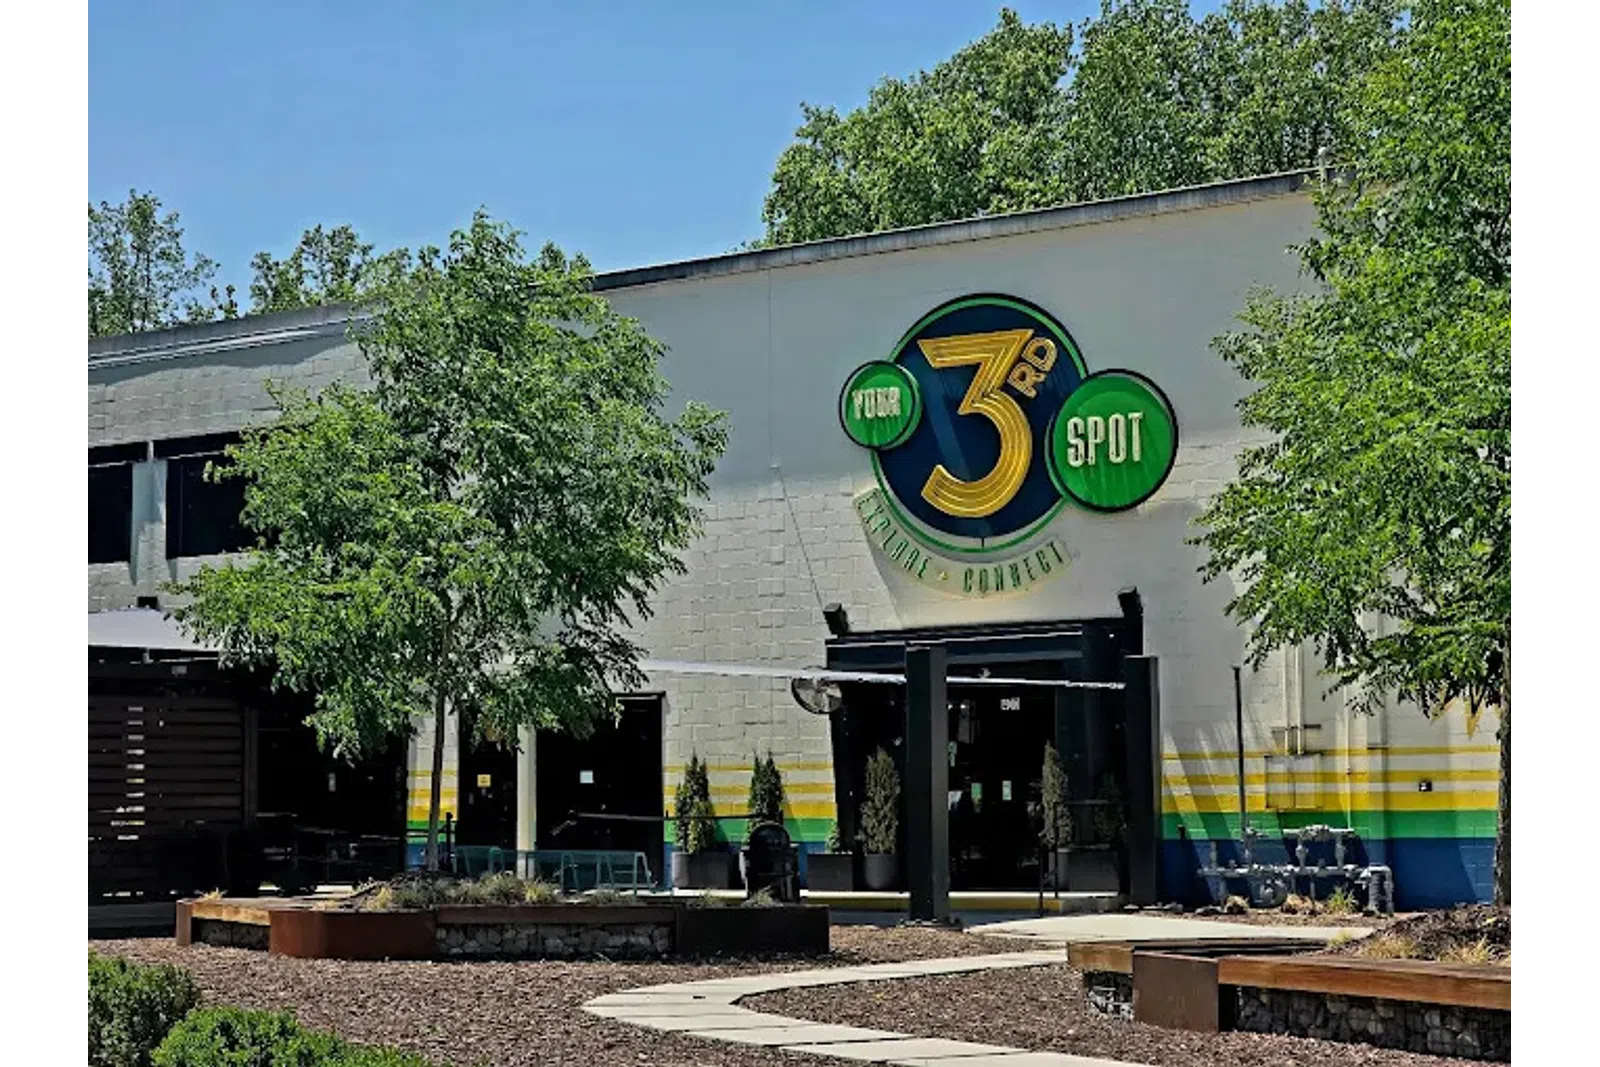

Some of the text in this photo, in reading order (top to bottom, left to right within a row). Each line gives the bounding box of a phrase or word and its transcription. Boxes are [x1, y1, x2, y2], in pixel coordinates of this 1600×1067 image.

[852, 386, 901, 420] YOUR
[1066, 411, 1144, 468] SPOT
[856, 491, 1064, 593] EXPLORE CONNECT
